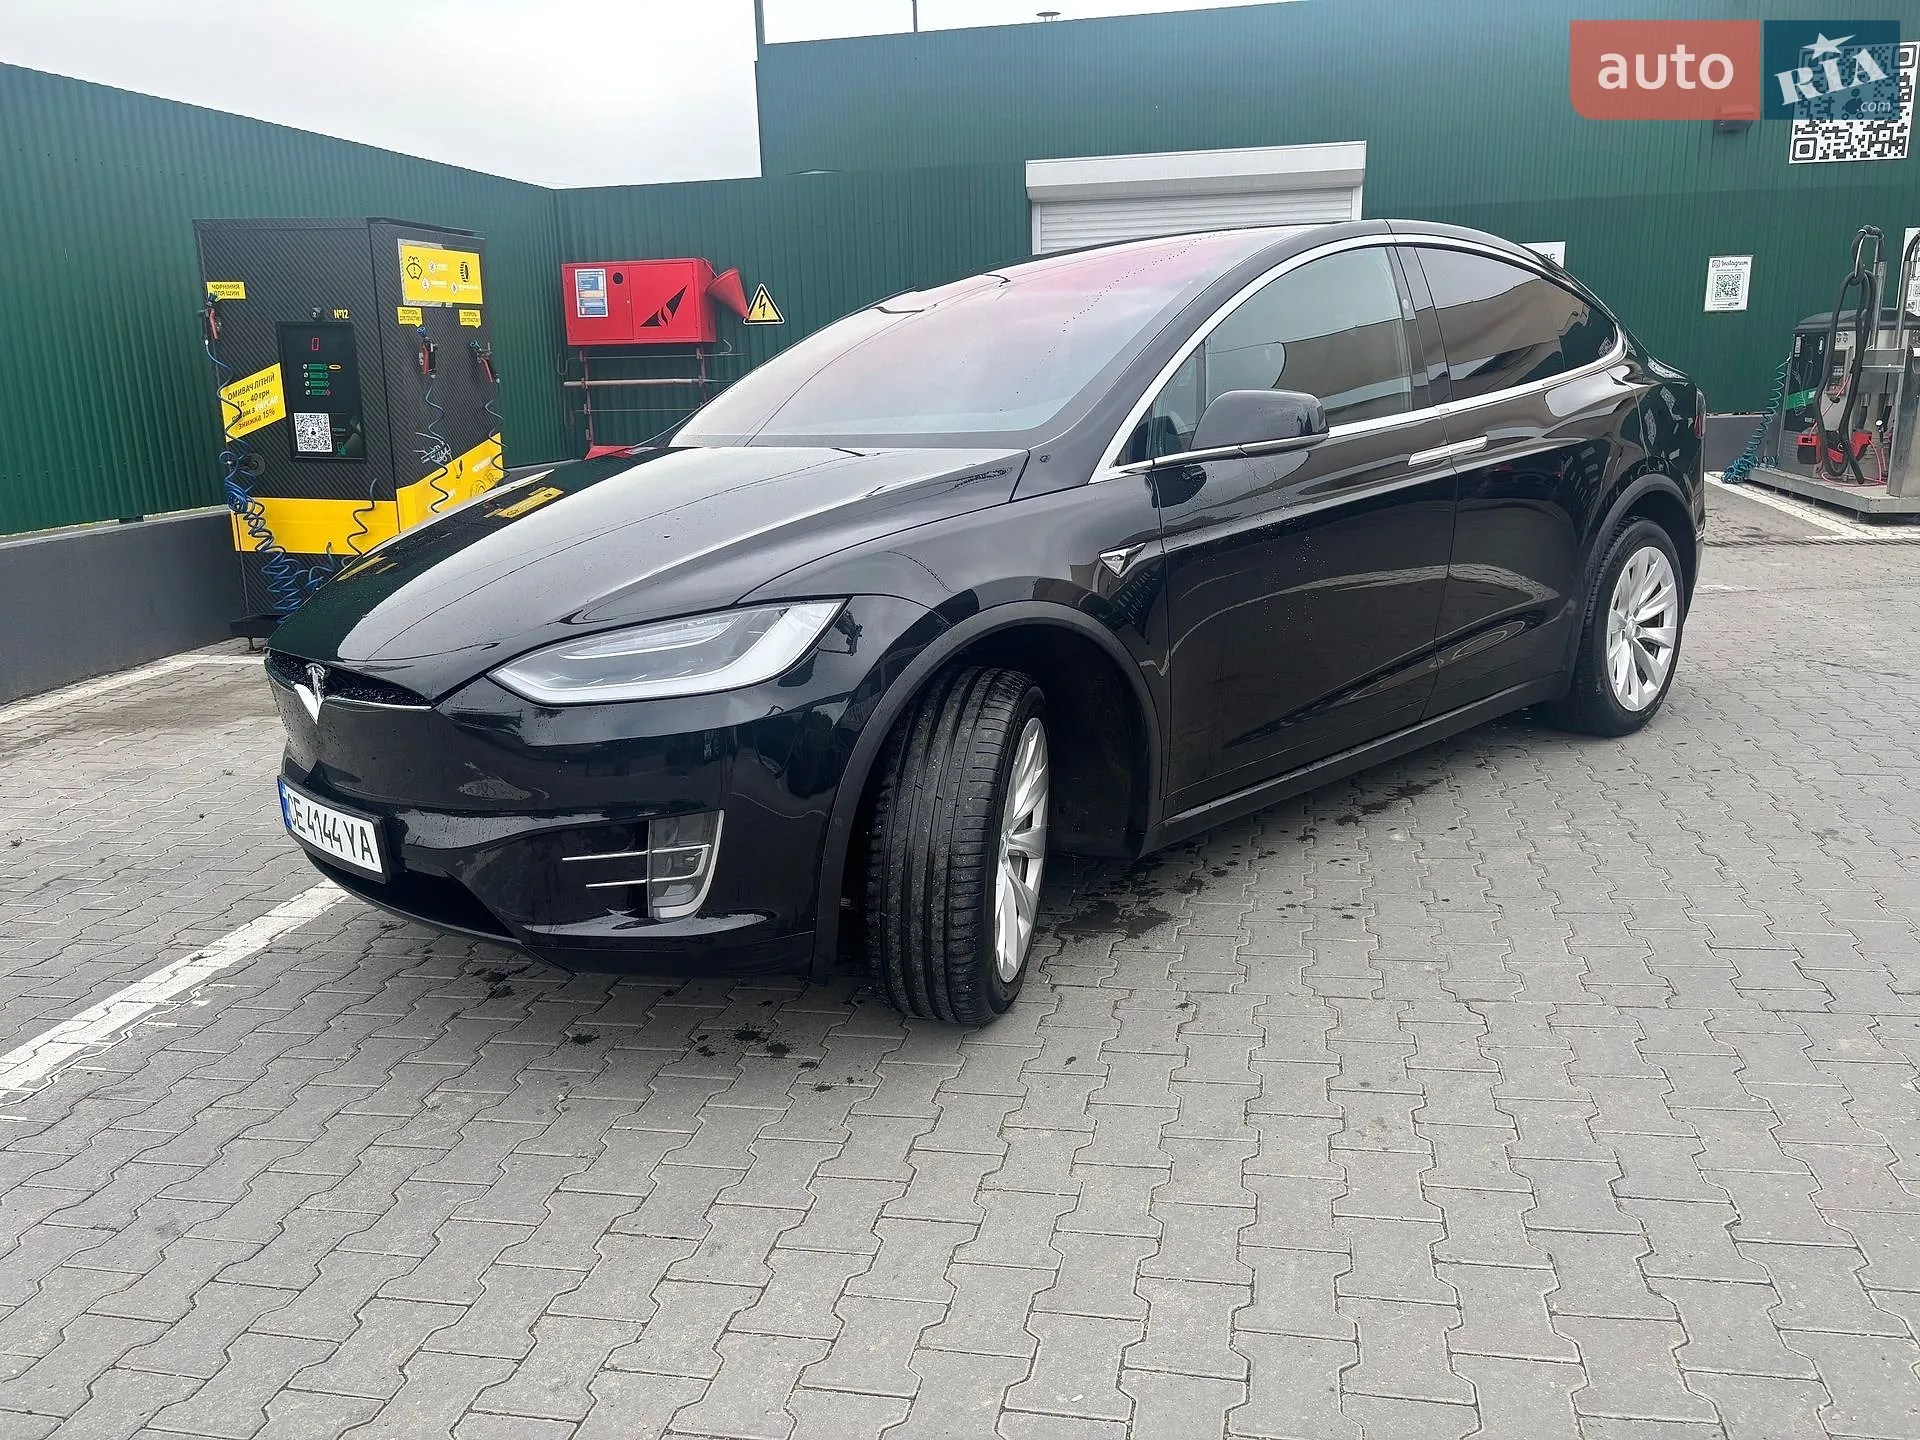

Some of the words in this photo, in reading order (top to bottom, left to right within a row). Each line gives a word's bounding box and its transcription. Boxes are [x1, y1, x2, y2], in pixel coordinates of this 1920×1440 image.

[227, 383, 254, 401] ОМИВАЧ
[254, 372, 275, 390] ЛІТНІЙ
[250, 394, 258, 402] 40
[263, 408, 276, 420] 15%
